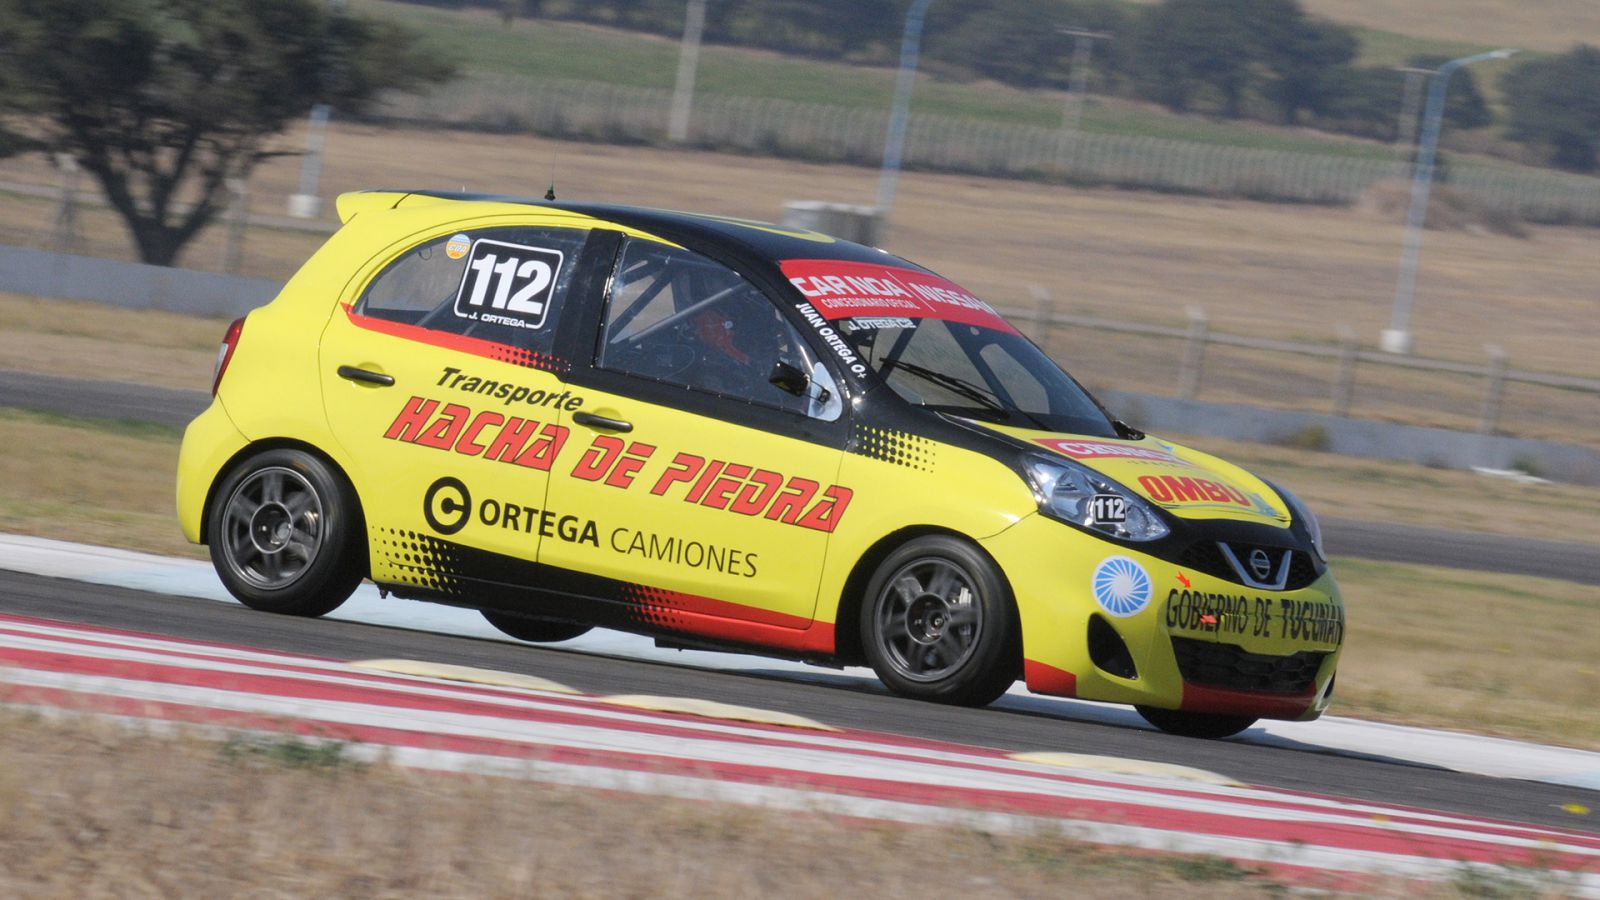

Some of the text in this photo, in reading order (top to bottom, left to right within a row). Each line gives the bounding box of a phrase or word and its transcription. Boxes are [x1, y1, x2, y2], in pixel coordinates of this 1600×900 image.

[471, 253, 551, 315] 112
[908, 282, 1001, 318] NISSAN
[468, 312, 526, 328] J. ORTEGA
[795, 302, 867, 379] JUAN ORTEGA O+
[436, 366, 584, 412] Transporte
[383, 396, 854, 534] HACHA DE PIEDRA
[1095, 498, 1125, 519] 112
[1138, 475, 1251, 507] OMBU
[479, 498, 600, 548] ORTEGA
[610, 527, 758, 578] CAMIONES
[1253, 597, 1272, 638] DE
